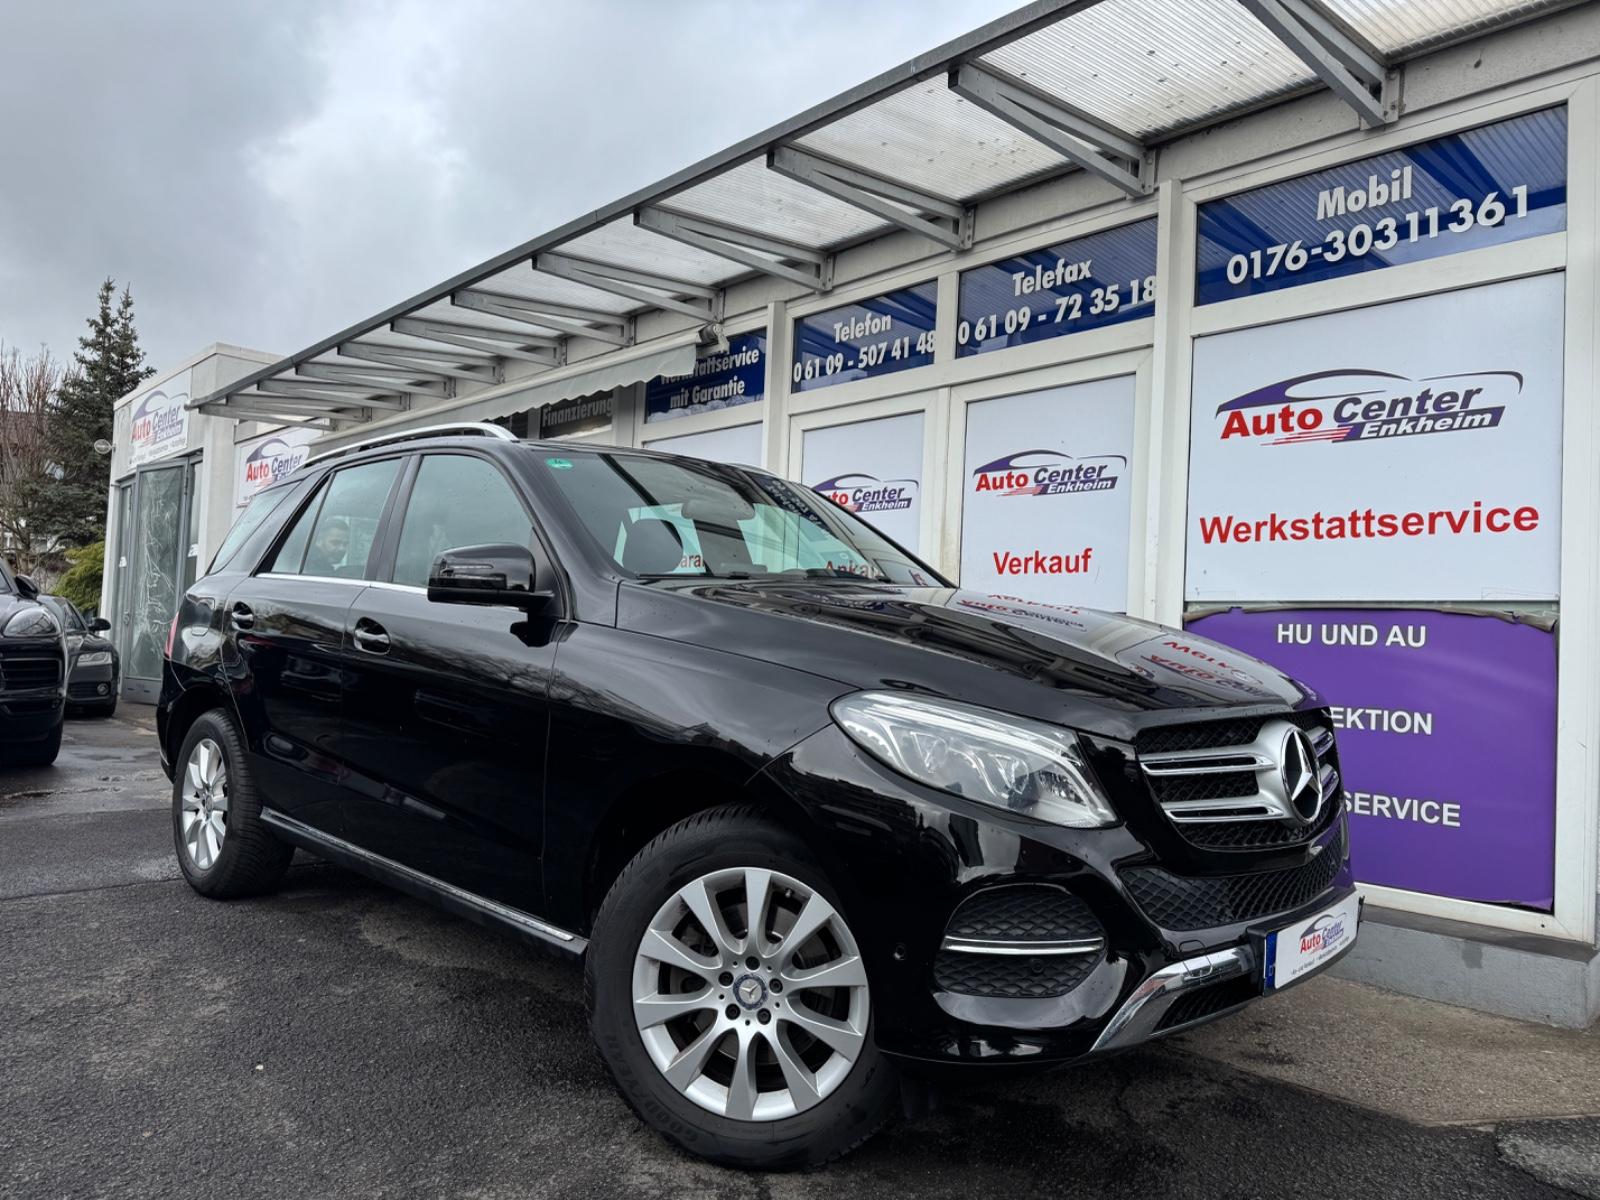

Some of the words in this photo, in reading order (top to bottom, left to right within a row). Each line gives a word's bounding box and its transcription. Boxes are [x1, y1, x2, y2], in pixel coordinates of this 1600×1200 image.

[1316, 165, 1413, 222] Mobil
[1012, 258, 1092, 297] Telefax
[957, 320, 970, 346] 0
[974, 314, 997, 342] 61
[1004, 306, 1032, 336] 09
[1055, 293, 1083, 325] 72
[1089, 284, 1120, 315] 35
[1130, 275, 1156, 306] 18
[832, 311, 892, 344] Telefon
[792, 361, 802, 383] 0
[804, 357, 820, 380] 61
[825, 353, 844, 377] 09
[857, 343, 887, 371] 507
[891, 336, 910, 360] 41
[915, 329, 936, 355] 48
[670, 387, 691, 409] mit
[692, 374, 745, 404] Garantie
[130, 417, 151, 444] Auto
[152, 404, 181, 432] Center
[542, 397, 614, 428] Finanzierung
[1220, 403, 1323, 441] Auto
[1333, 386, 1484, 424] Center
[1359, 410, 1493, 440] Enkheim
[246, 461, 270, 483] Auto
[272, 453, 303, 474] Center
[975, 470, 1029, 493] Auto
[1033, 462, 1108, 485] Center
[851, 485, 905, 503] Center
[1047, 476, 1114, 495] Enkheim
[861, 499, 909, 512] Enkheim
[1199, 501, 1539, 544] Werkstattservice
[993, 547, 1093, 576] Verkauf
[1277, 623, 1312, 645] HU
[1321, 623, 1378, 646] UND
[1385, 625, 1427, 648] AU
[1300, 934, 1321, 954] Auto
